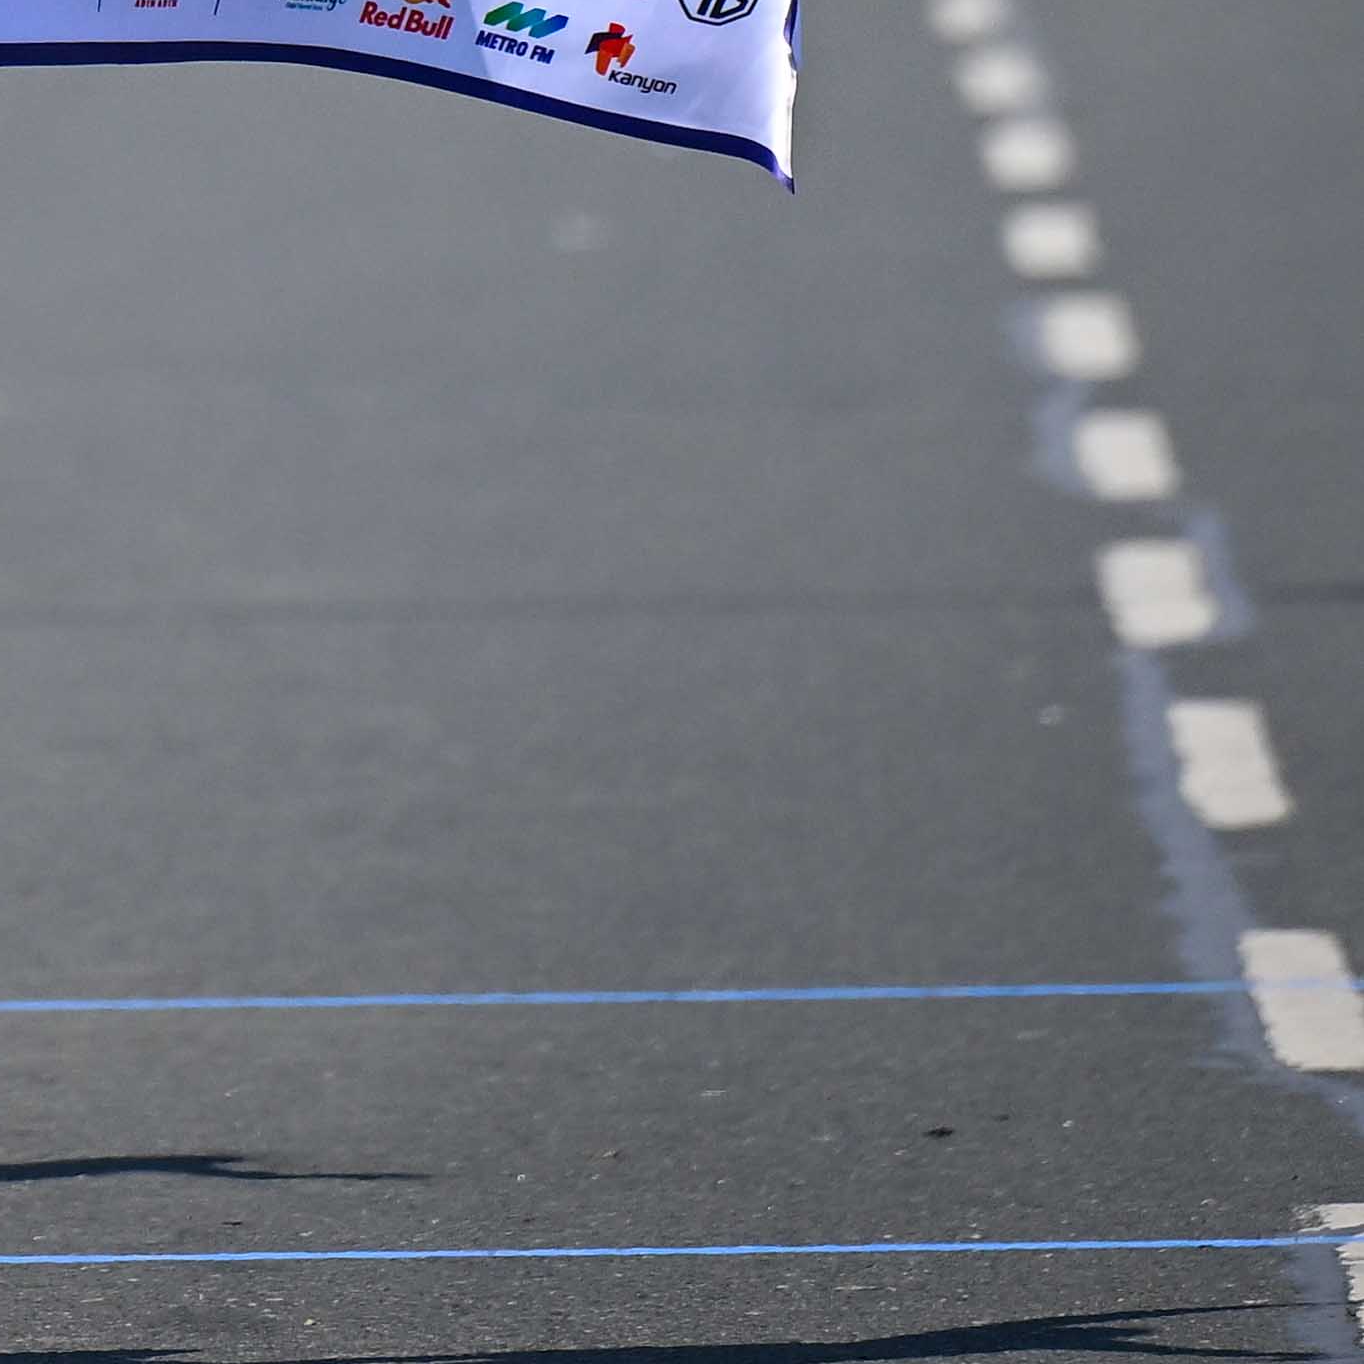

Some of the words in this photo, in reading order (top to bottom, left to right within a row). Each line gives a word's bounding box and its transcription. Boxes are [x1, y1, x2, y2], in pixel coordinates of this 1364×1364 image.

[359, 1, 407, 30] Red
[404, 9, 454, 40] Bull
[475, 30, 528, 57] METRO
[530, 45, 556, 65] FM
